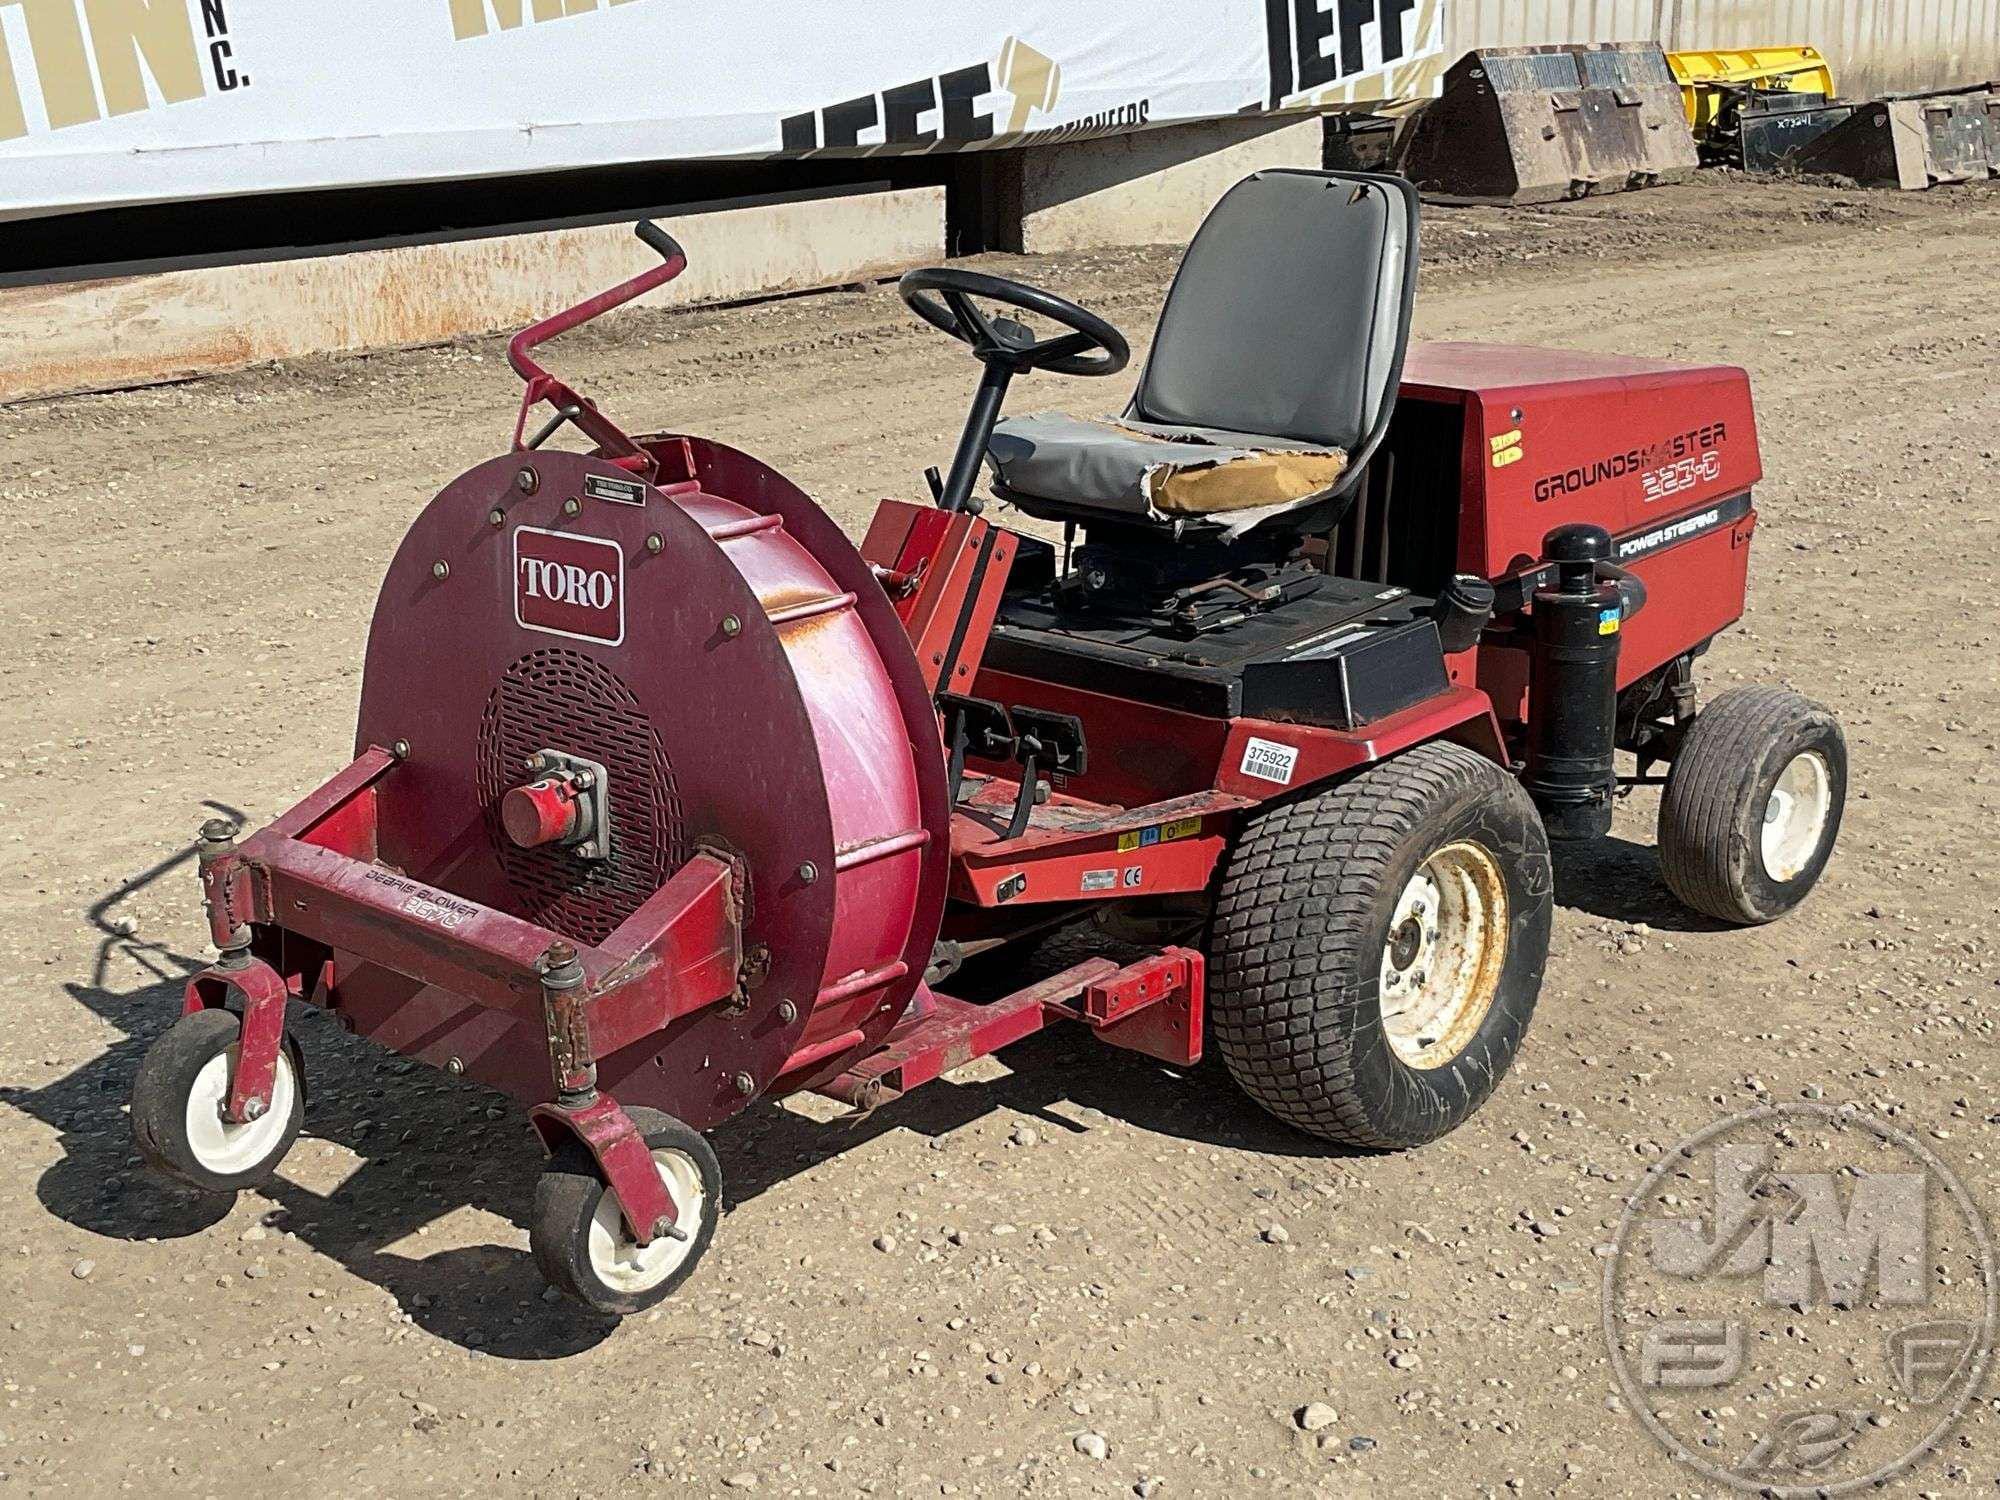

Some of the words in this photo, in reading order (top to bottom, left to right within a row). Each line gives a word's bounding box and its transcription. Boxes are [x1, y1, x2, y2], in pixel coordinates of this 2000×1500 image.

[1534, 422, 1727, 503] GROUNDSMASTER
[1619, 529, 1664, 558] POWER
[1664, 509, 1719, 541] STEERING
[520, 557, 616, 610] TORO
[1248, 746, 1292, 768] 375922
[365, 869, 417, 895] DEBRIS
[416, 888, 479, 919] BLOWER
